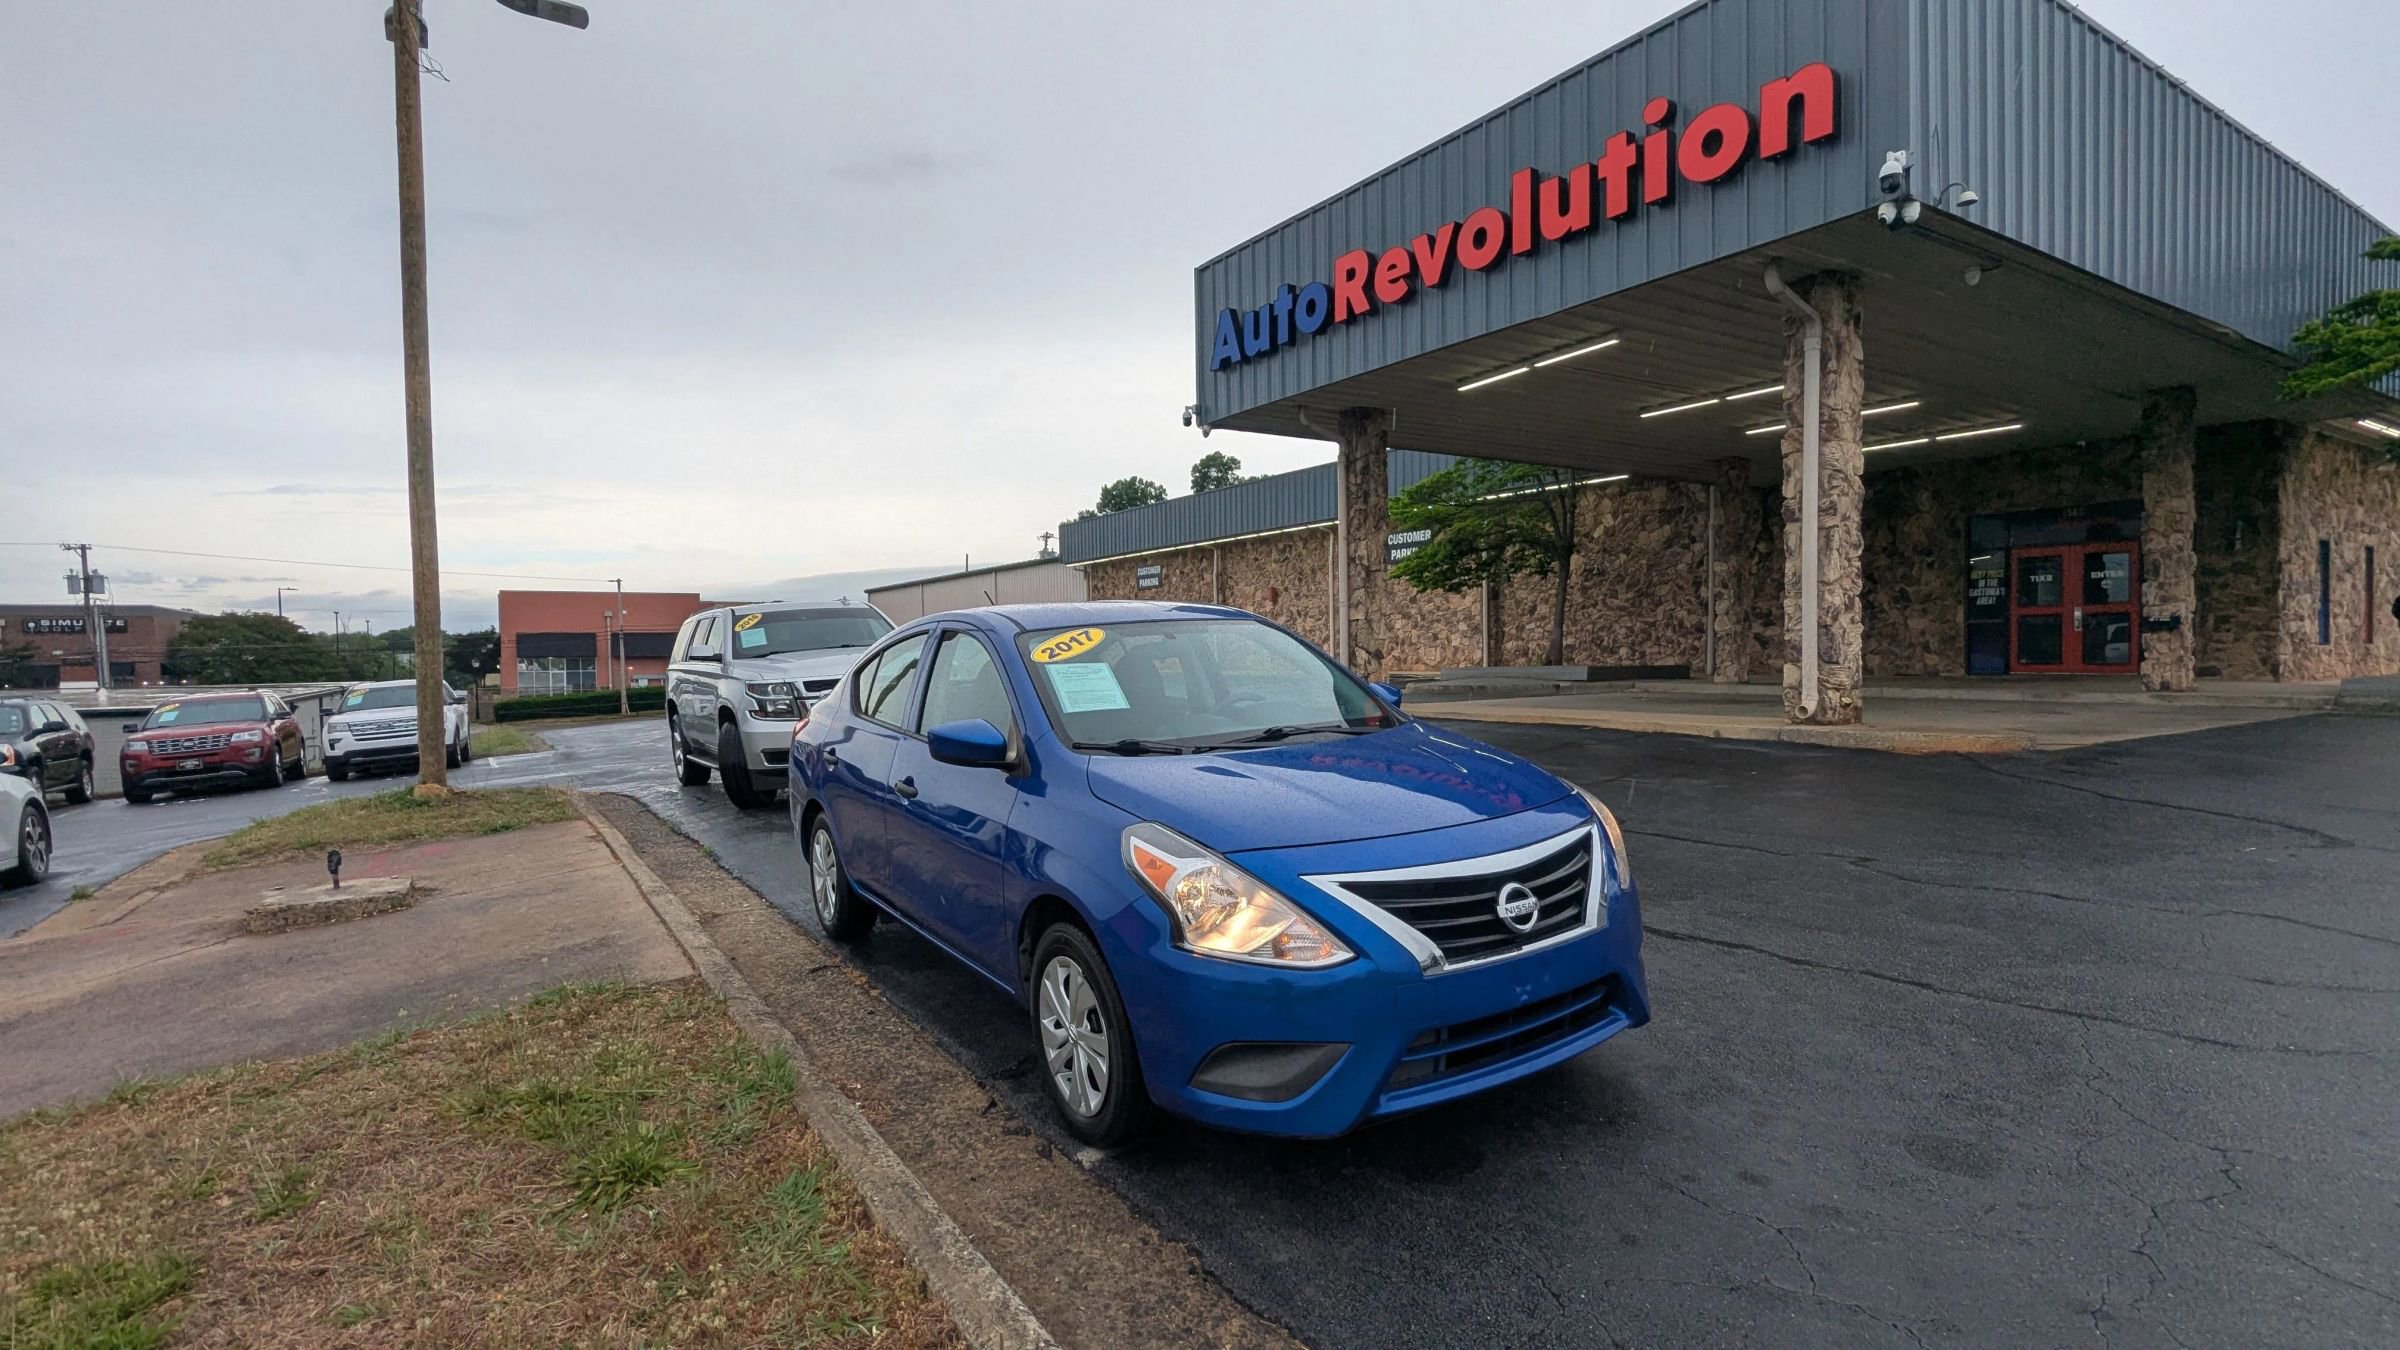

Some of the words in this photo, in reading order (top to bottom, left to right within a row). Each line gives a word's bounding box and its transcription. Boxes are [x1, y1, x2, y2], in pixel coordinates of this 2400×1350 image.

[1388, 530, 1431, 545] CUSTOMER
[1391, 546, 1419, 560] PARK
[1138, 566, 1161, 576] CUSTOMER
[2090, 570, 2124, 579] ENTER
[41, 619, 125, 627] SIMUTE
[1041, 630, 1095, 660] 2017
[1505, 901, 1538, 915] NISSAN
